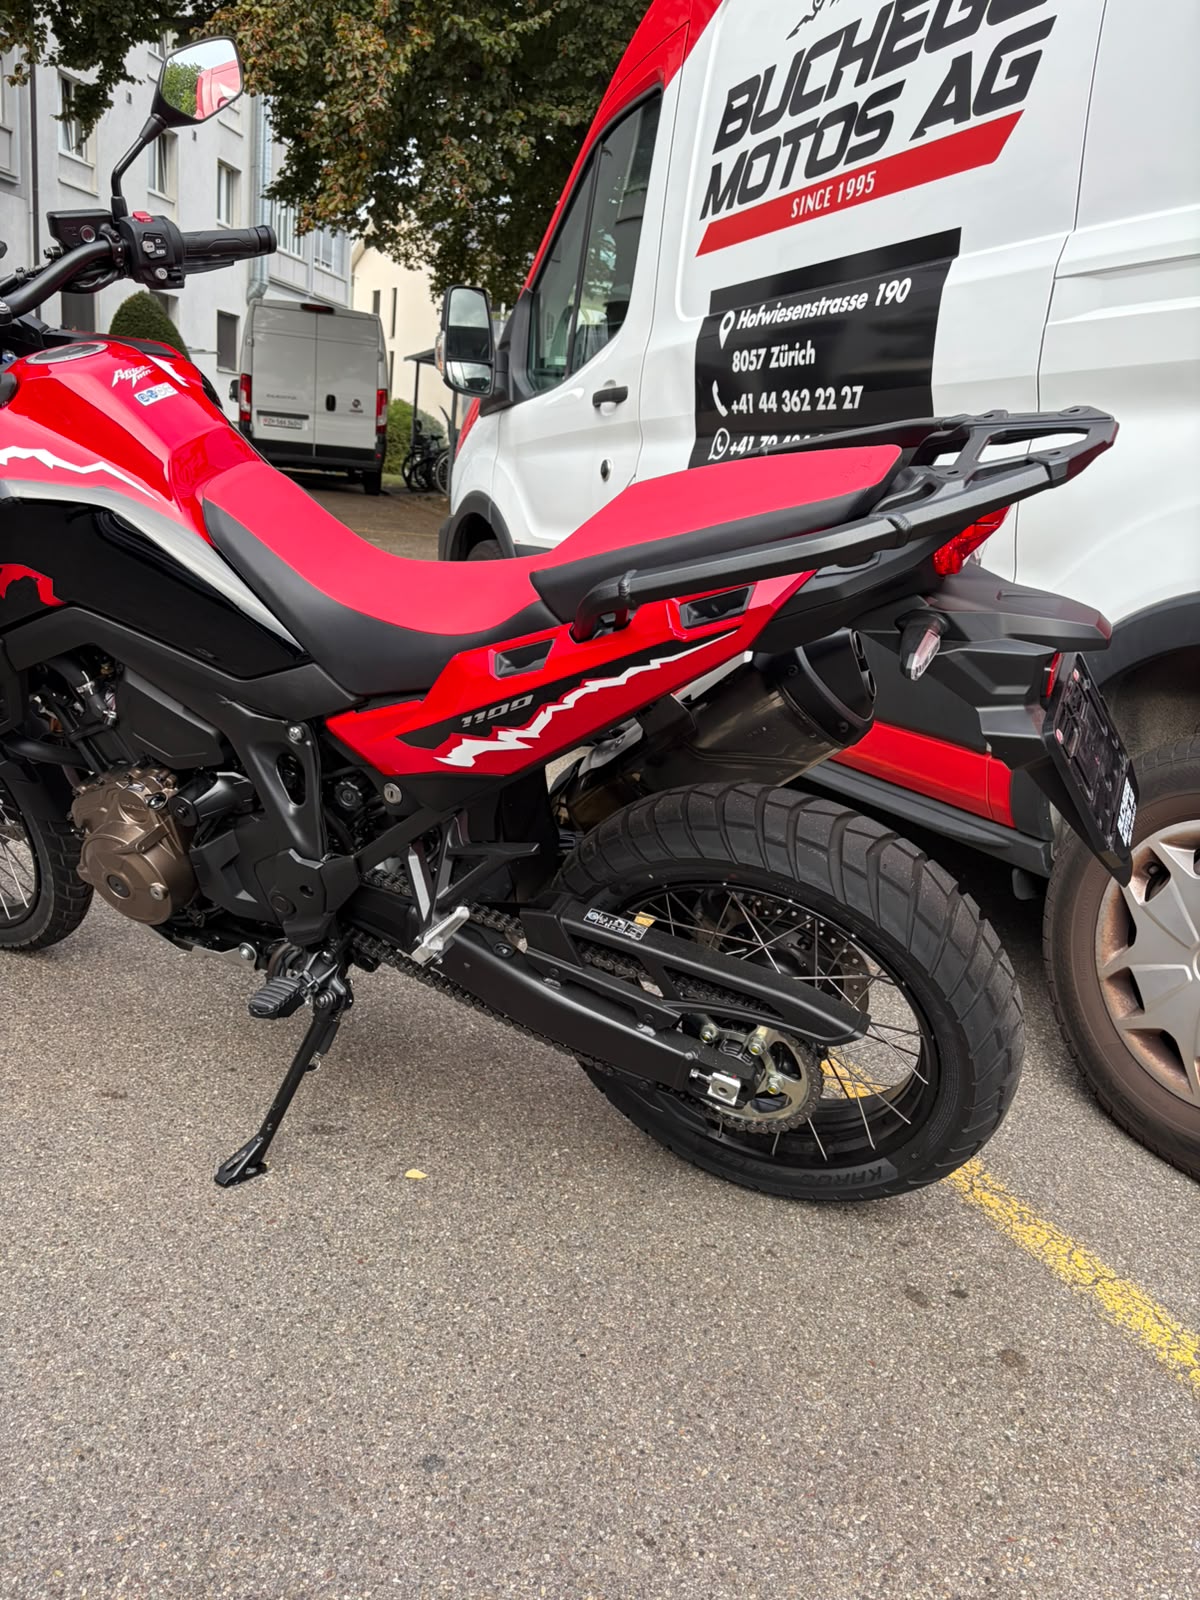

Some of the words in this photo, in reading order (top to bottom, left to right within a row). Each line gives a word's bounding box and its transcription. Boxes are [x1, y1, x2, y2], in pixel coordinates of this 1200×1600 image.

[712, 0, 1047, 155] BUCHEG
[700, 79, 906, 220] MOTOS
[909, 15, 1057, 142] AG
[791, 185, 833, 218] SINCE
[837, 170, 876, 203] 1995
[736, 292, 868, 330] Hofwiesenstrasse
[875, 277, 912, 306] 190
[732, 347, 767, 373] 8057
[769, 339, 815, 369] Zürich
[731, 393, 754, 414] +41
[758, 391, 778, 413] 44
[781, 388, 811, 413] 362
[815, 386, 837, 410] 22
[841, 385, 864, 409] 27
[729, 435, 755, 456] +41
[461, 694, 534, 728] 1100
